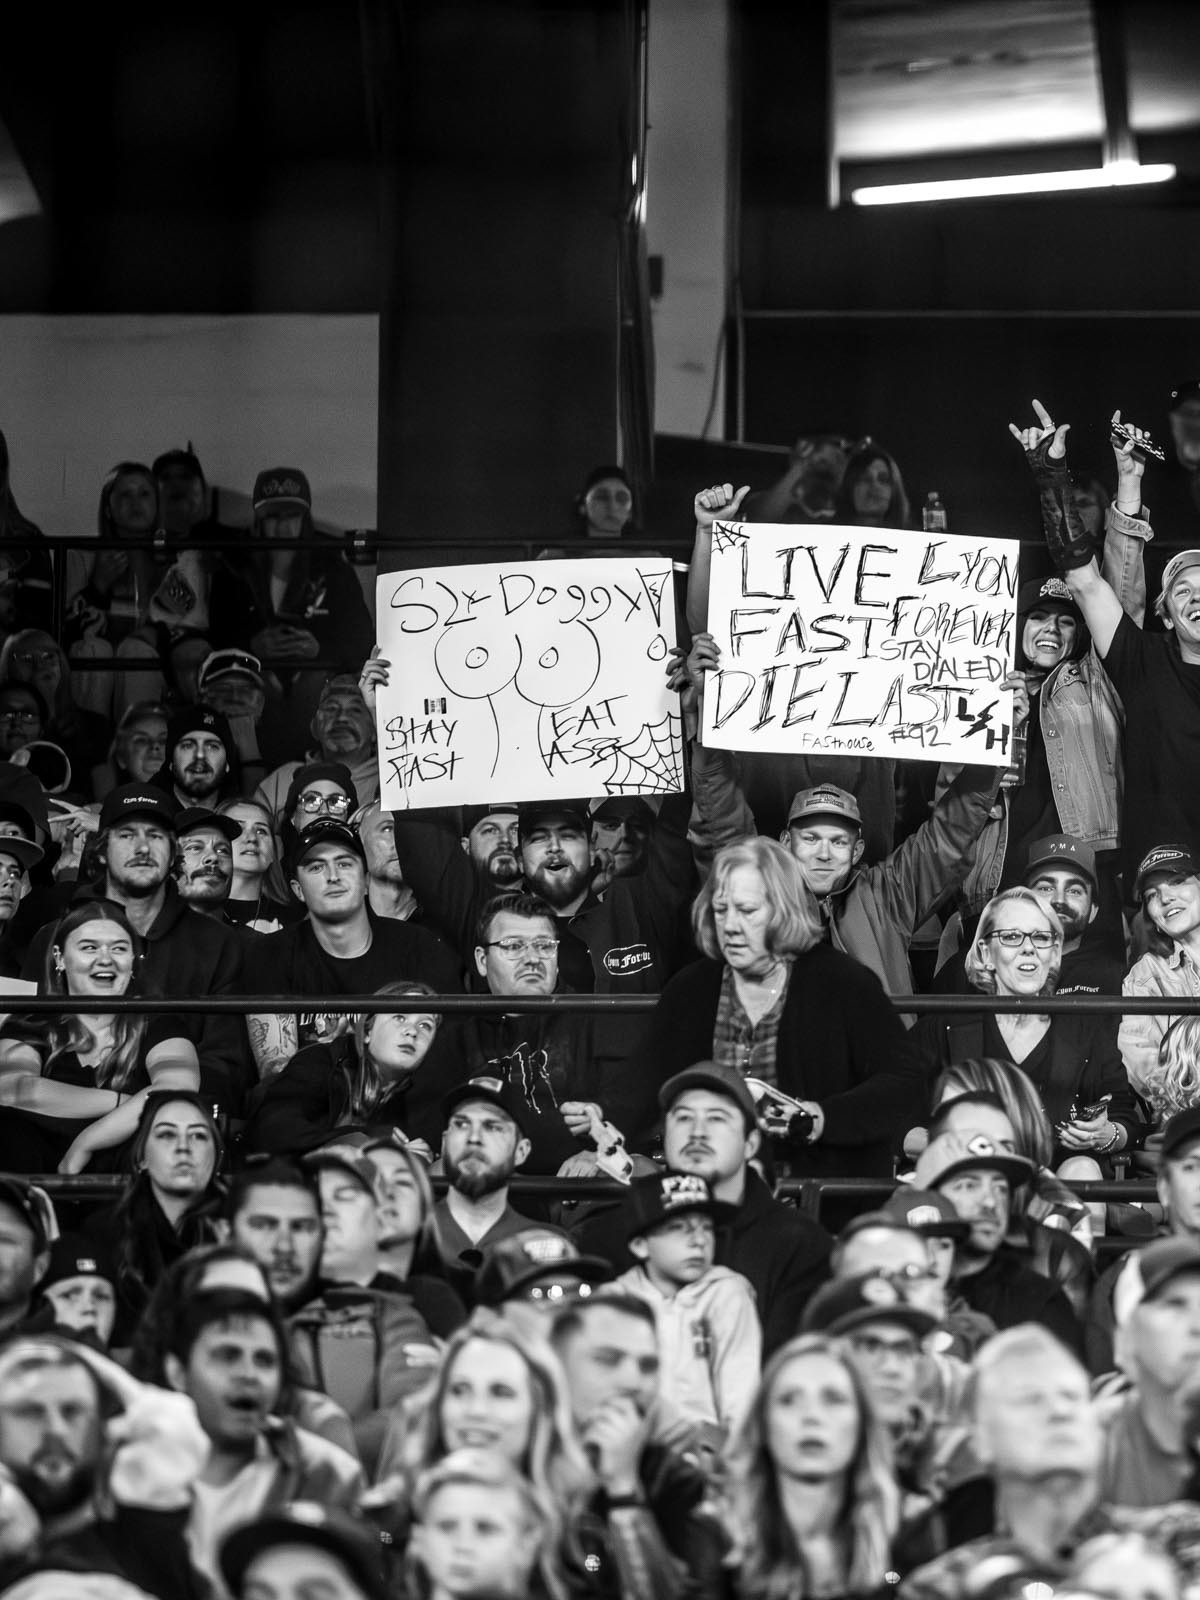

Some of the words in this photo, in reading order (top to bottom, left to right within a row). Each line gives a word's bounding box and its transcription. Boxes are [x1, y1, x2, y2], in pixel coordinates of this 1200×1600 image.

[741, 541, 898, 608] LIVE
[729, 607, 892, 659] FAST
[886, 594, 1016, 658] FOREVER
[880, 639, 942, 670] STAY
[550, 694, 629, 741] EAT
[710, 657, 828, 733] DIE
[827, 671, 979, 729] LAST
[888, 724, 952, 748] #92
